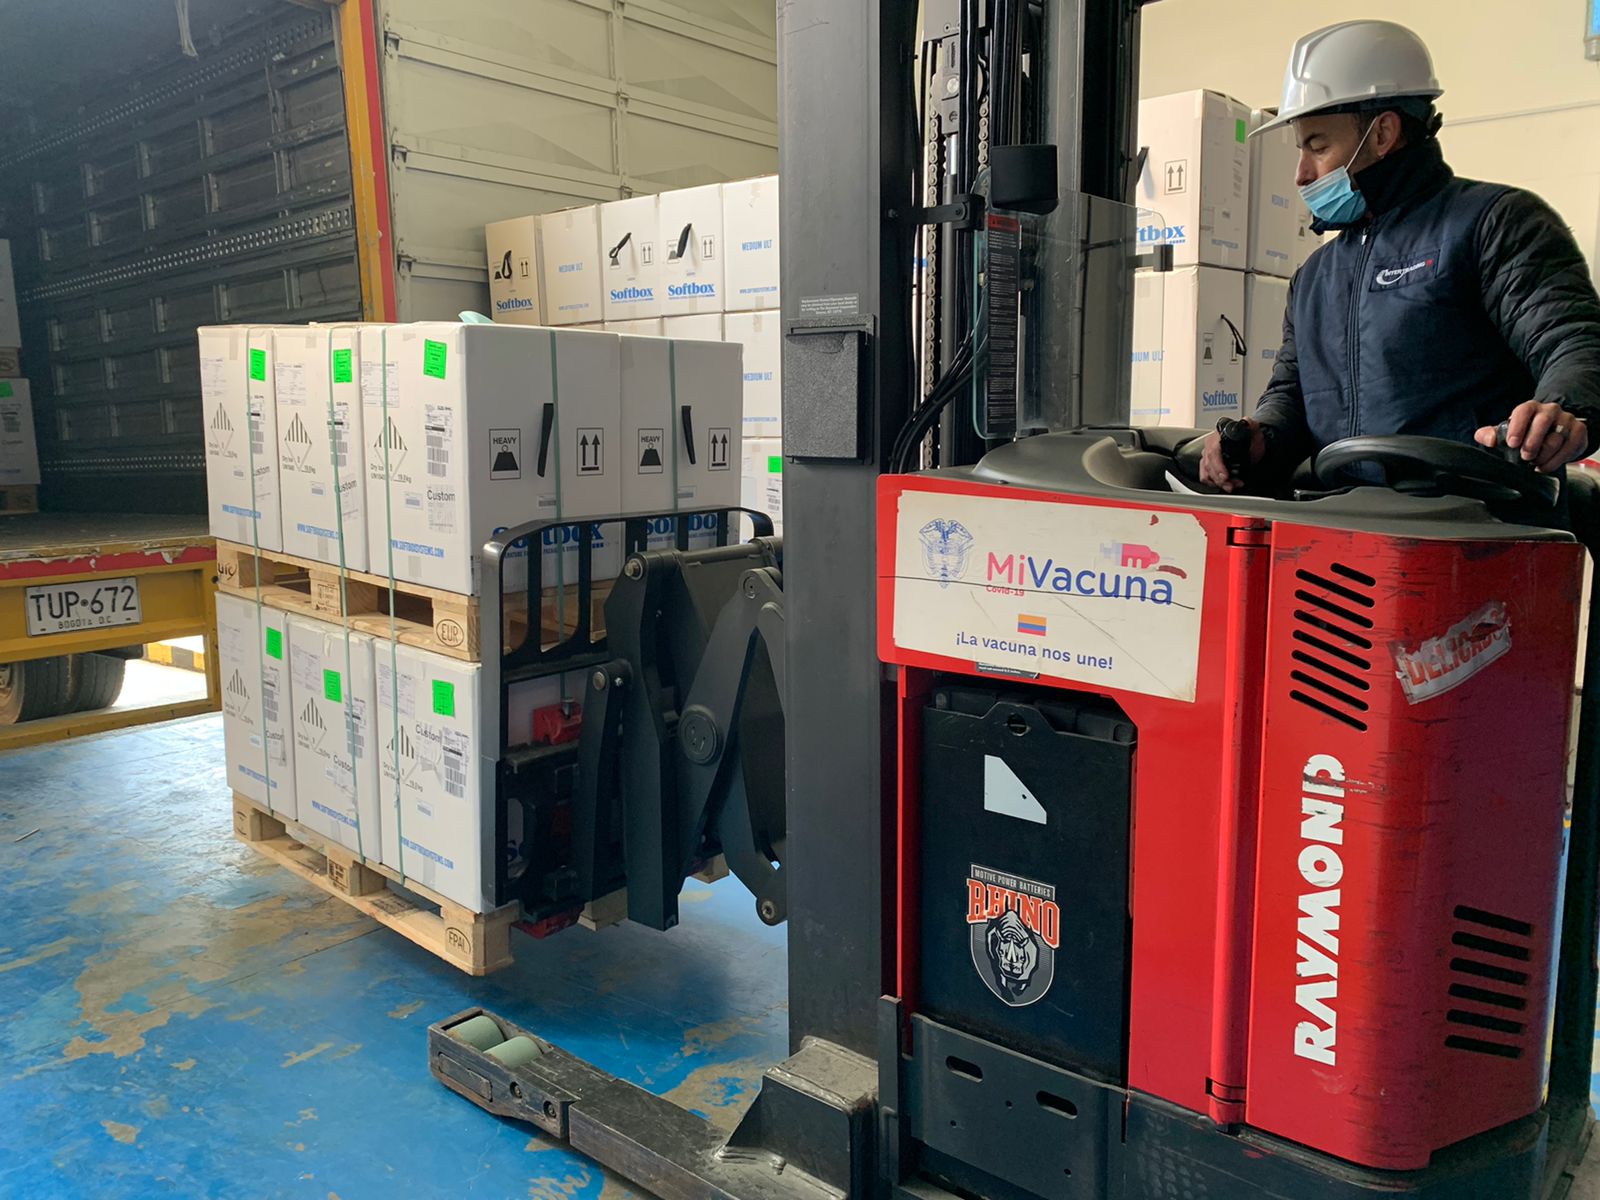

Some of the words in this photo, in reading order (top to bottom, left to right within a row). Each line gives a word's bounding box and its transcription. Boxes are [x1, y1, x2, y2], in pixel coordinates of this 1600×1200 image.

[1136, 224, 1185, 242] tbox
[742, 241, 762, 251] MEDIUM
[763, 239, 773, 249] ULT
[610, 287, 654, 301] Softbox
[668, 282, 715, 297] Softbox
[496, 297, 533, 311] Softbox
[1202, 390, 1238, 407] Softbox
[492, 436, 518, 445] HEAVY
[640, 435, 661, 443] HEAVY
[427, 489, 456, 502] Custom
[986, 551, 1174, 606] MiVacuna
[986, 584, 1025, 597] Covid-19
[58, 619, 93, 630] BOGOTA
[441, 623, 459, 644] EUR
[956, 632, 978, 647] ¡La
[982, 636, 1037, 657] vacuna
[1042, 647, 1071, 663] nos
[1077, 654, 1114, 670] une!
[974, 868, 996, 882] MOTIVE
[997, 875, 1017, 888] POWER
[1019, 881, 1051, 898] BATTERIES
[966, 877, 1060, 950] RHINO
[1294, 753, 1345, 1066] RAYMOND
